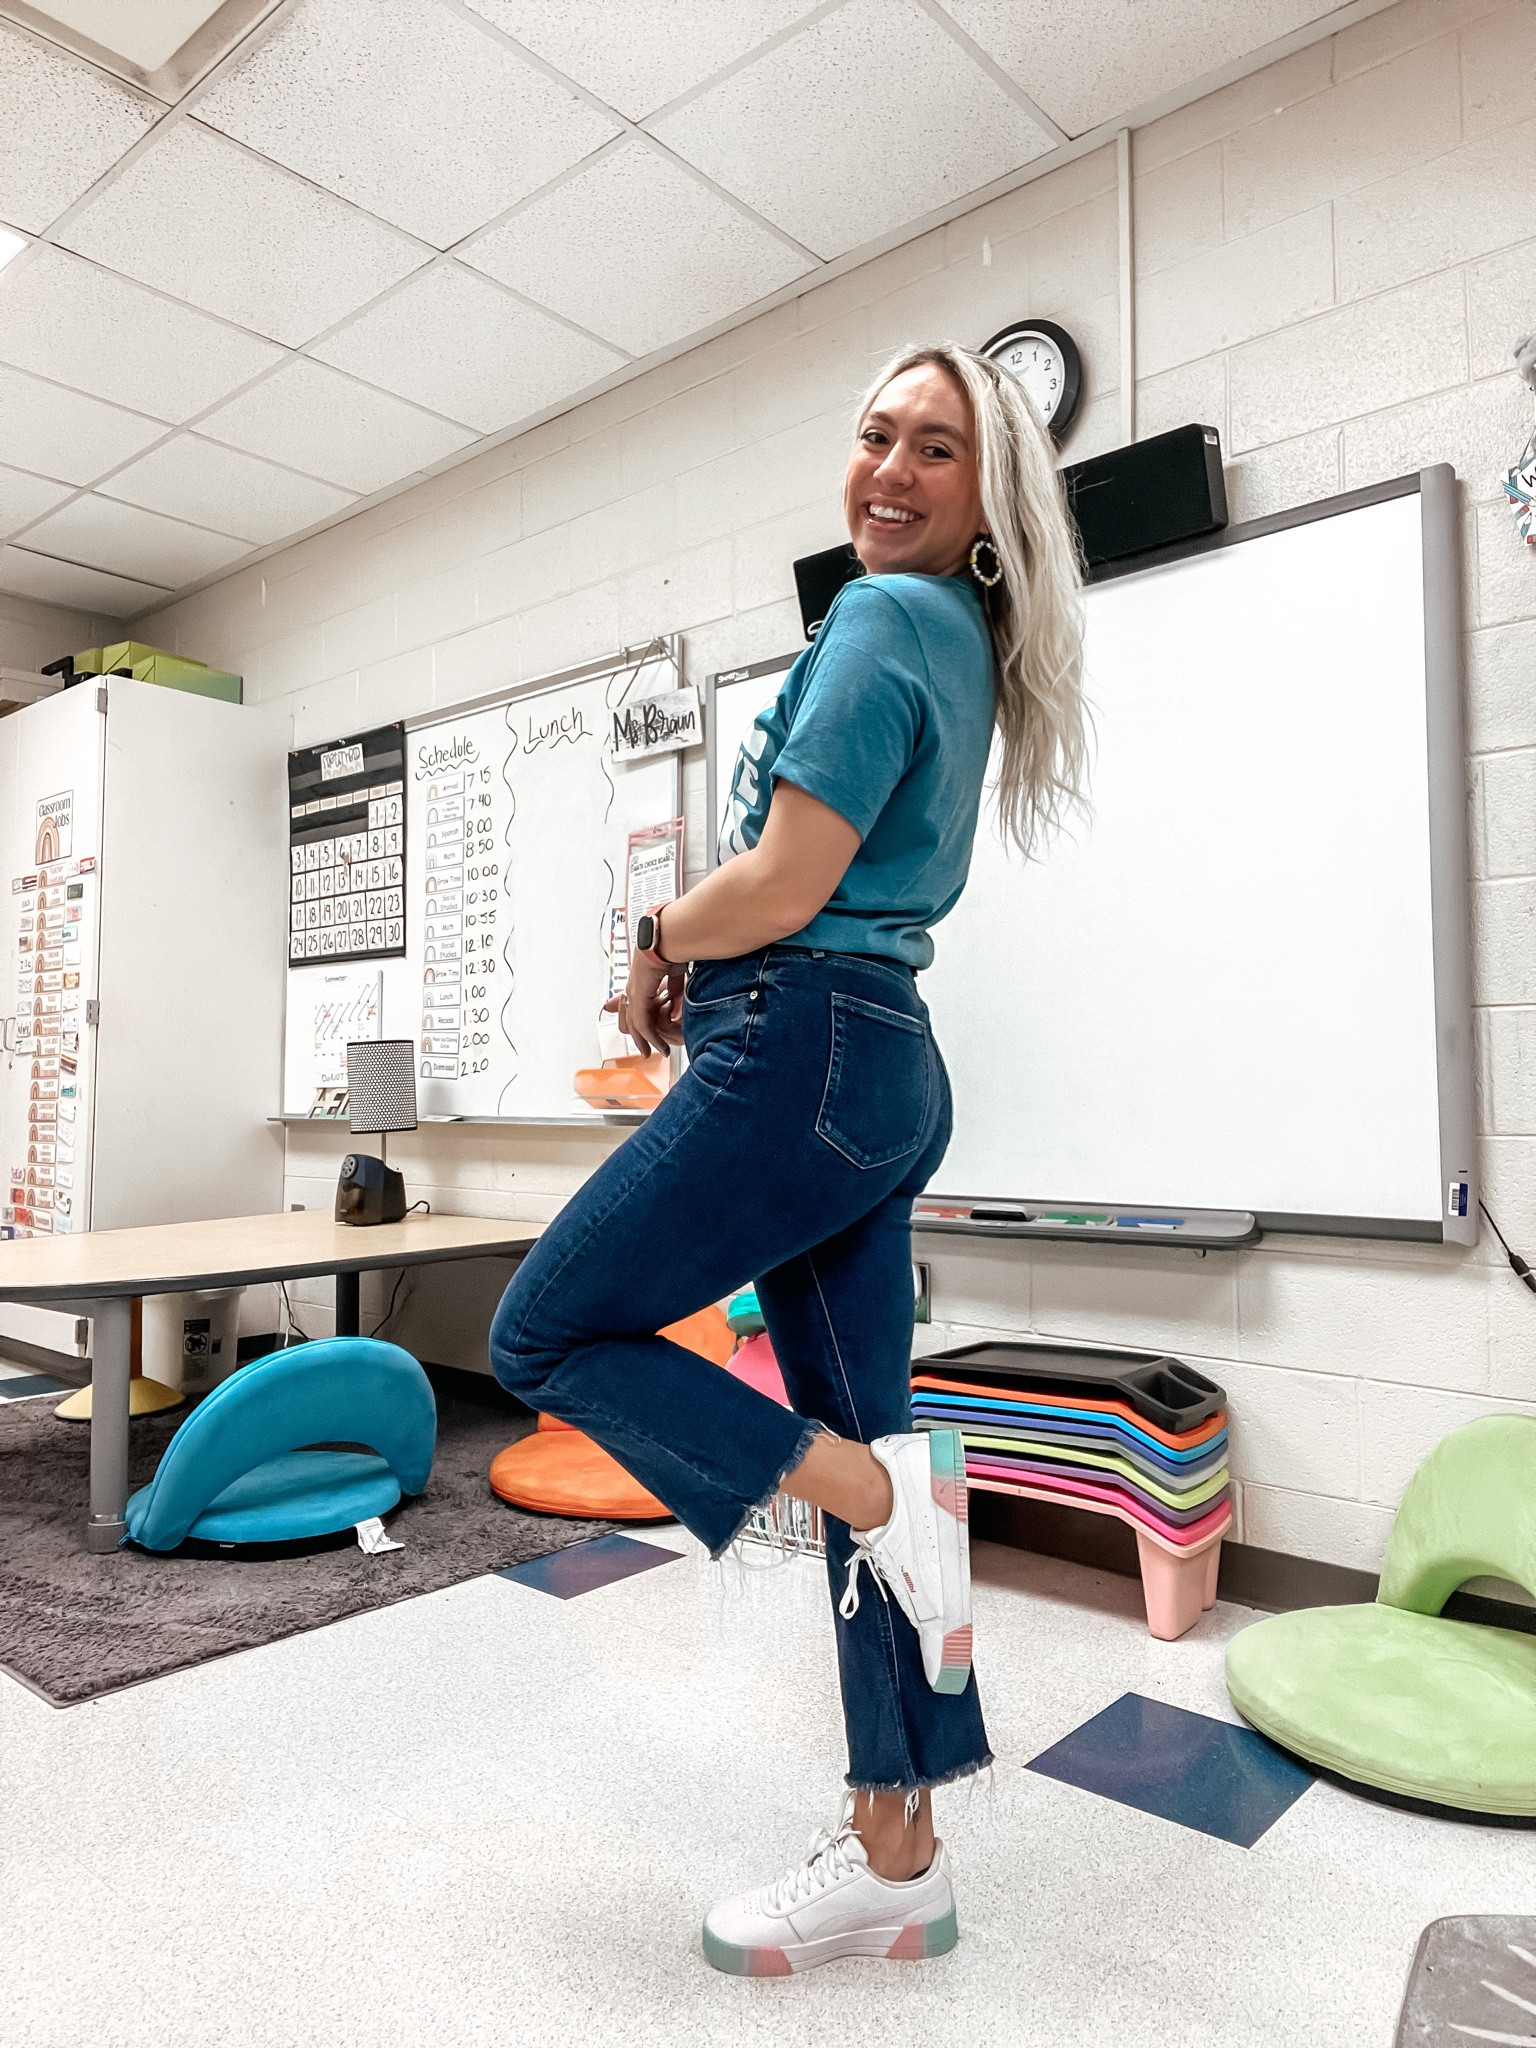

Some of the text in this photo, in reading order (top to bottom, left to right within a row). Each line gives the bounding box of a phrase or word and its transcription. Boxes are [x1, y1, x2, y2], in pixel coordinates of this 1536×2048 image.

[1010, 351, 1023, 365] 12
[1032, 351, 1037, 361] 1
[1044, 359, 1051, 371] 2
[1049, 378, 1057, 389] 3
[1044, 401, 1051, 412] 4
[528, 706, 584, 744] Lunch
[418, 735, 477, 769] Schedule
[375, 802, 398, 825] 1 2
[296, 851, 301, 868] 3
[310, 849, 315, 863] 4
[324, 846, 330, 862] 5
[356, 839, 362, 857] 7
[373, 836, 380, 852] 8
[391, 833, 397, 849] 9
[295, 863, 399, 897] 10 11 12 13 14 15 16
[466, 889, 498, 905] 10:30
[296, 893, 400, 926] 17 18 19 20 21 22 23
[465, 909, 497, 928] 10:55
[294, 922, 401, 954] 24 25 26 27 28 29 30
[465, 958, 496, 977] 12:30
[463, 1007, 490, 1026] 1:30
